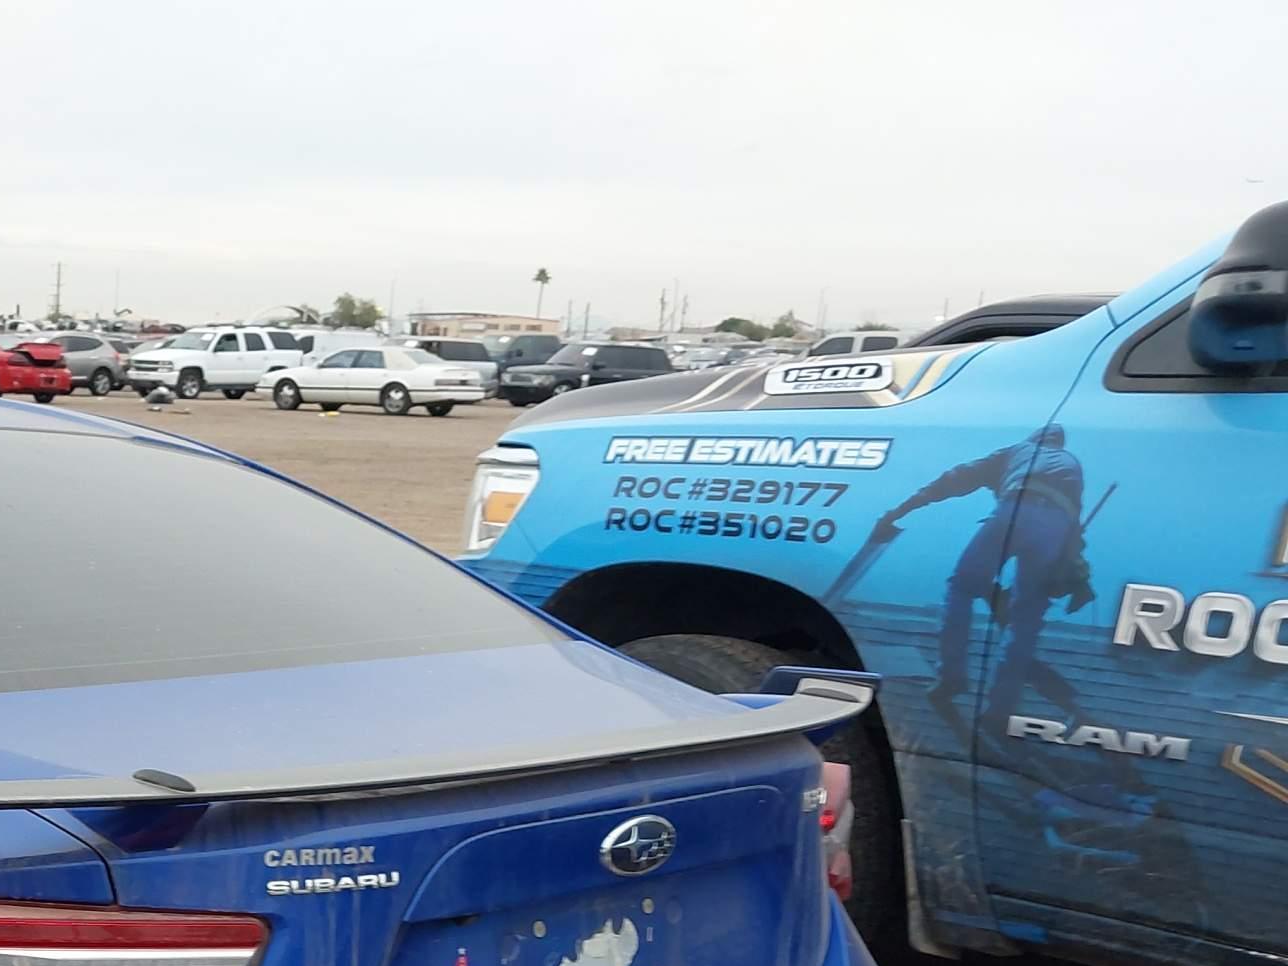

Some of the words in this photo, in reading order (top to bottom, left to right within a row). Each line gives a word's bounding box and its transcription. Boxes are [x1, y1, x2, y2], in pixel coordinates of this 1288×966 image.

[784, 363, 883, 383] 1500
[605, 437, 687, 462] FREE
[687, 437, 892, 468] ESTIMATES
[613, 475, 686, 500] ROC
[687, 477, 850, 508] #329177
[604, 507, 675, 533] ROC
[677, 509, 837, 543] #351020
[1007, 715, 1192, 761] RAM
[266, 871, 400, 896] SUBARU
